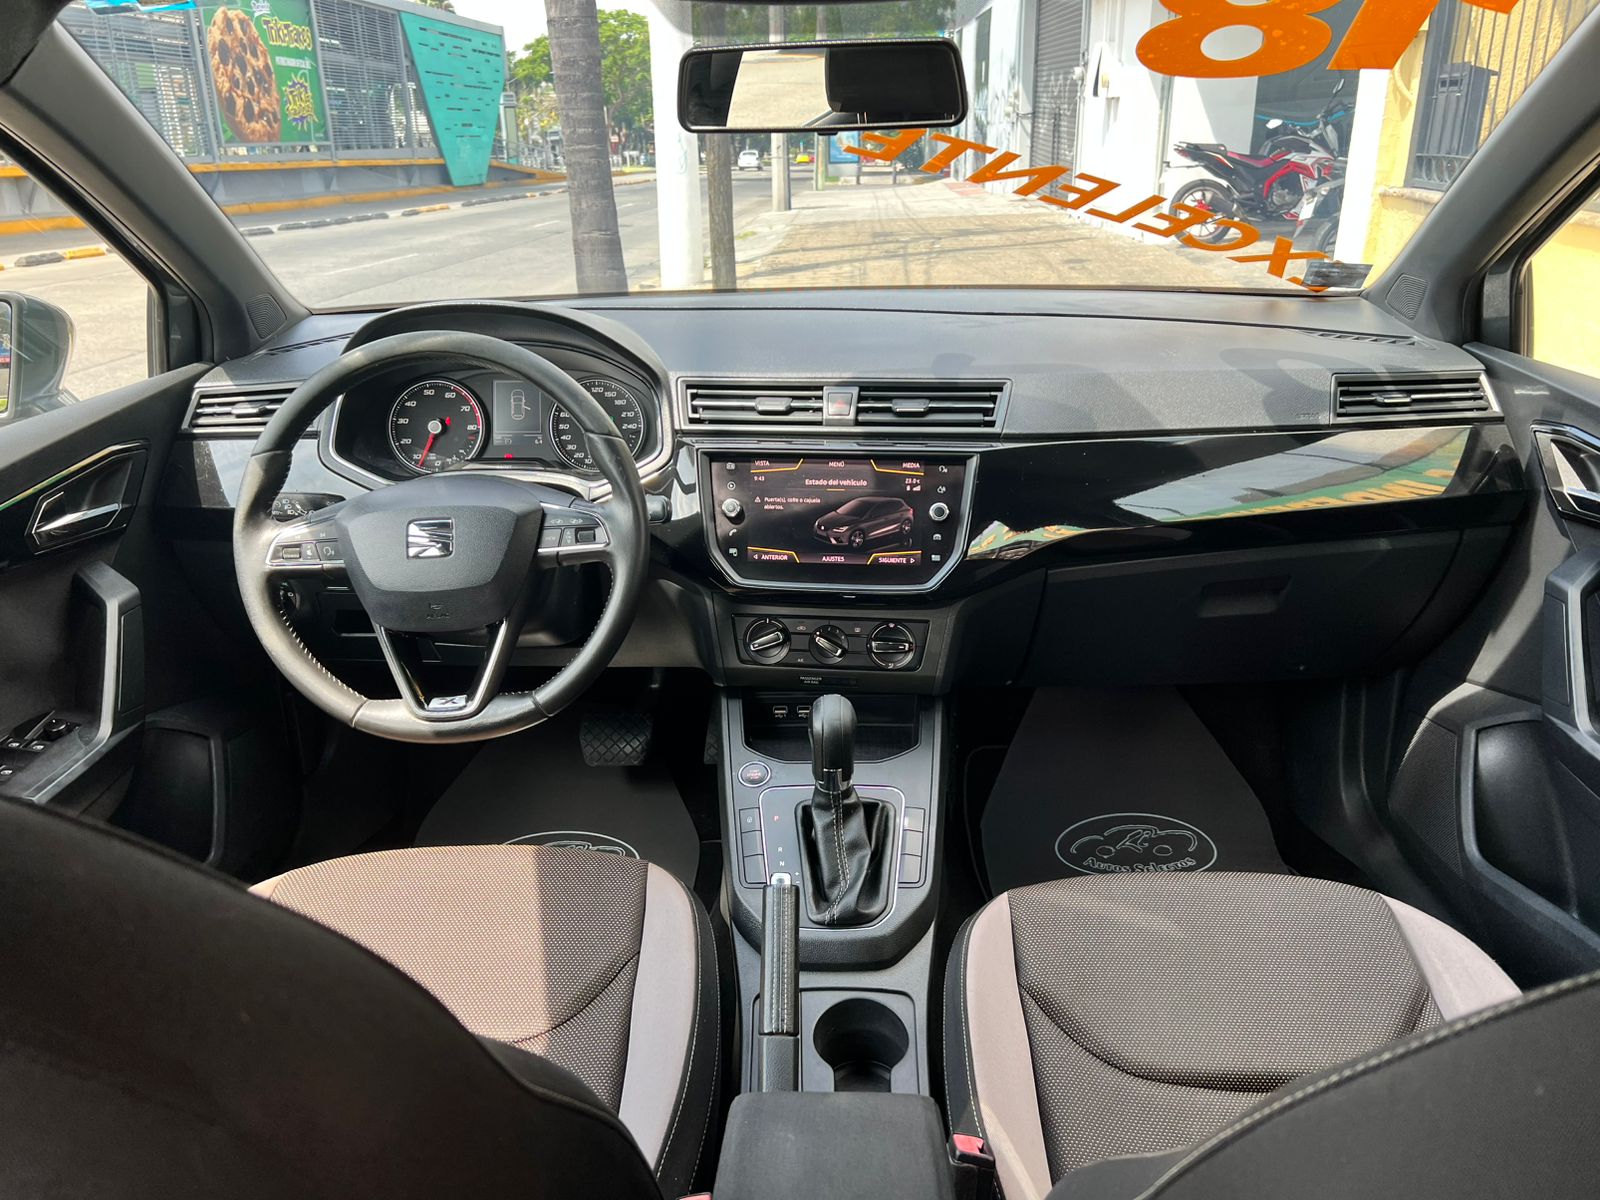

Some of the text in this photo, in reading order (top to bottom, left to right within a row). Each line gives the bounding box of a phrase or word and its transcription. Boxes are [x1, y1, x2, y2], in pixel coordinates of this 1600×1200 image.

[828, 460, 845, 468] MENÚ
[804, 478, 868, 487] Estado del vehículo
